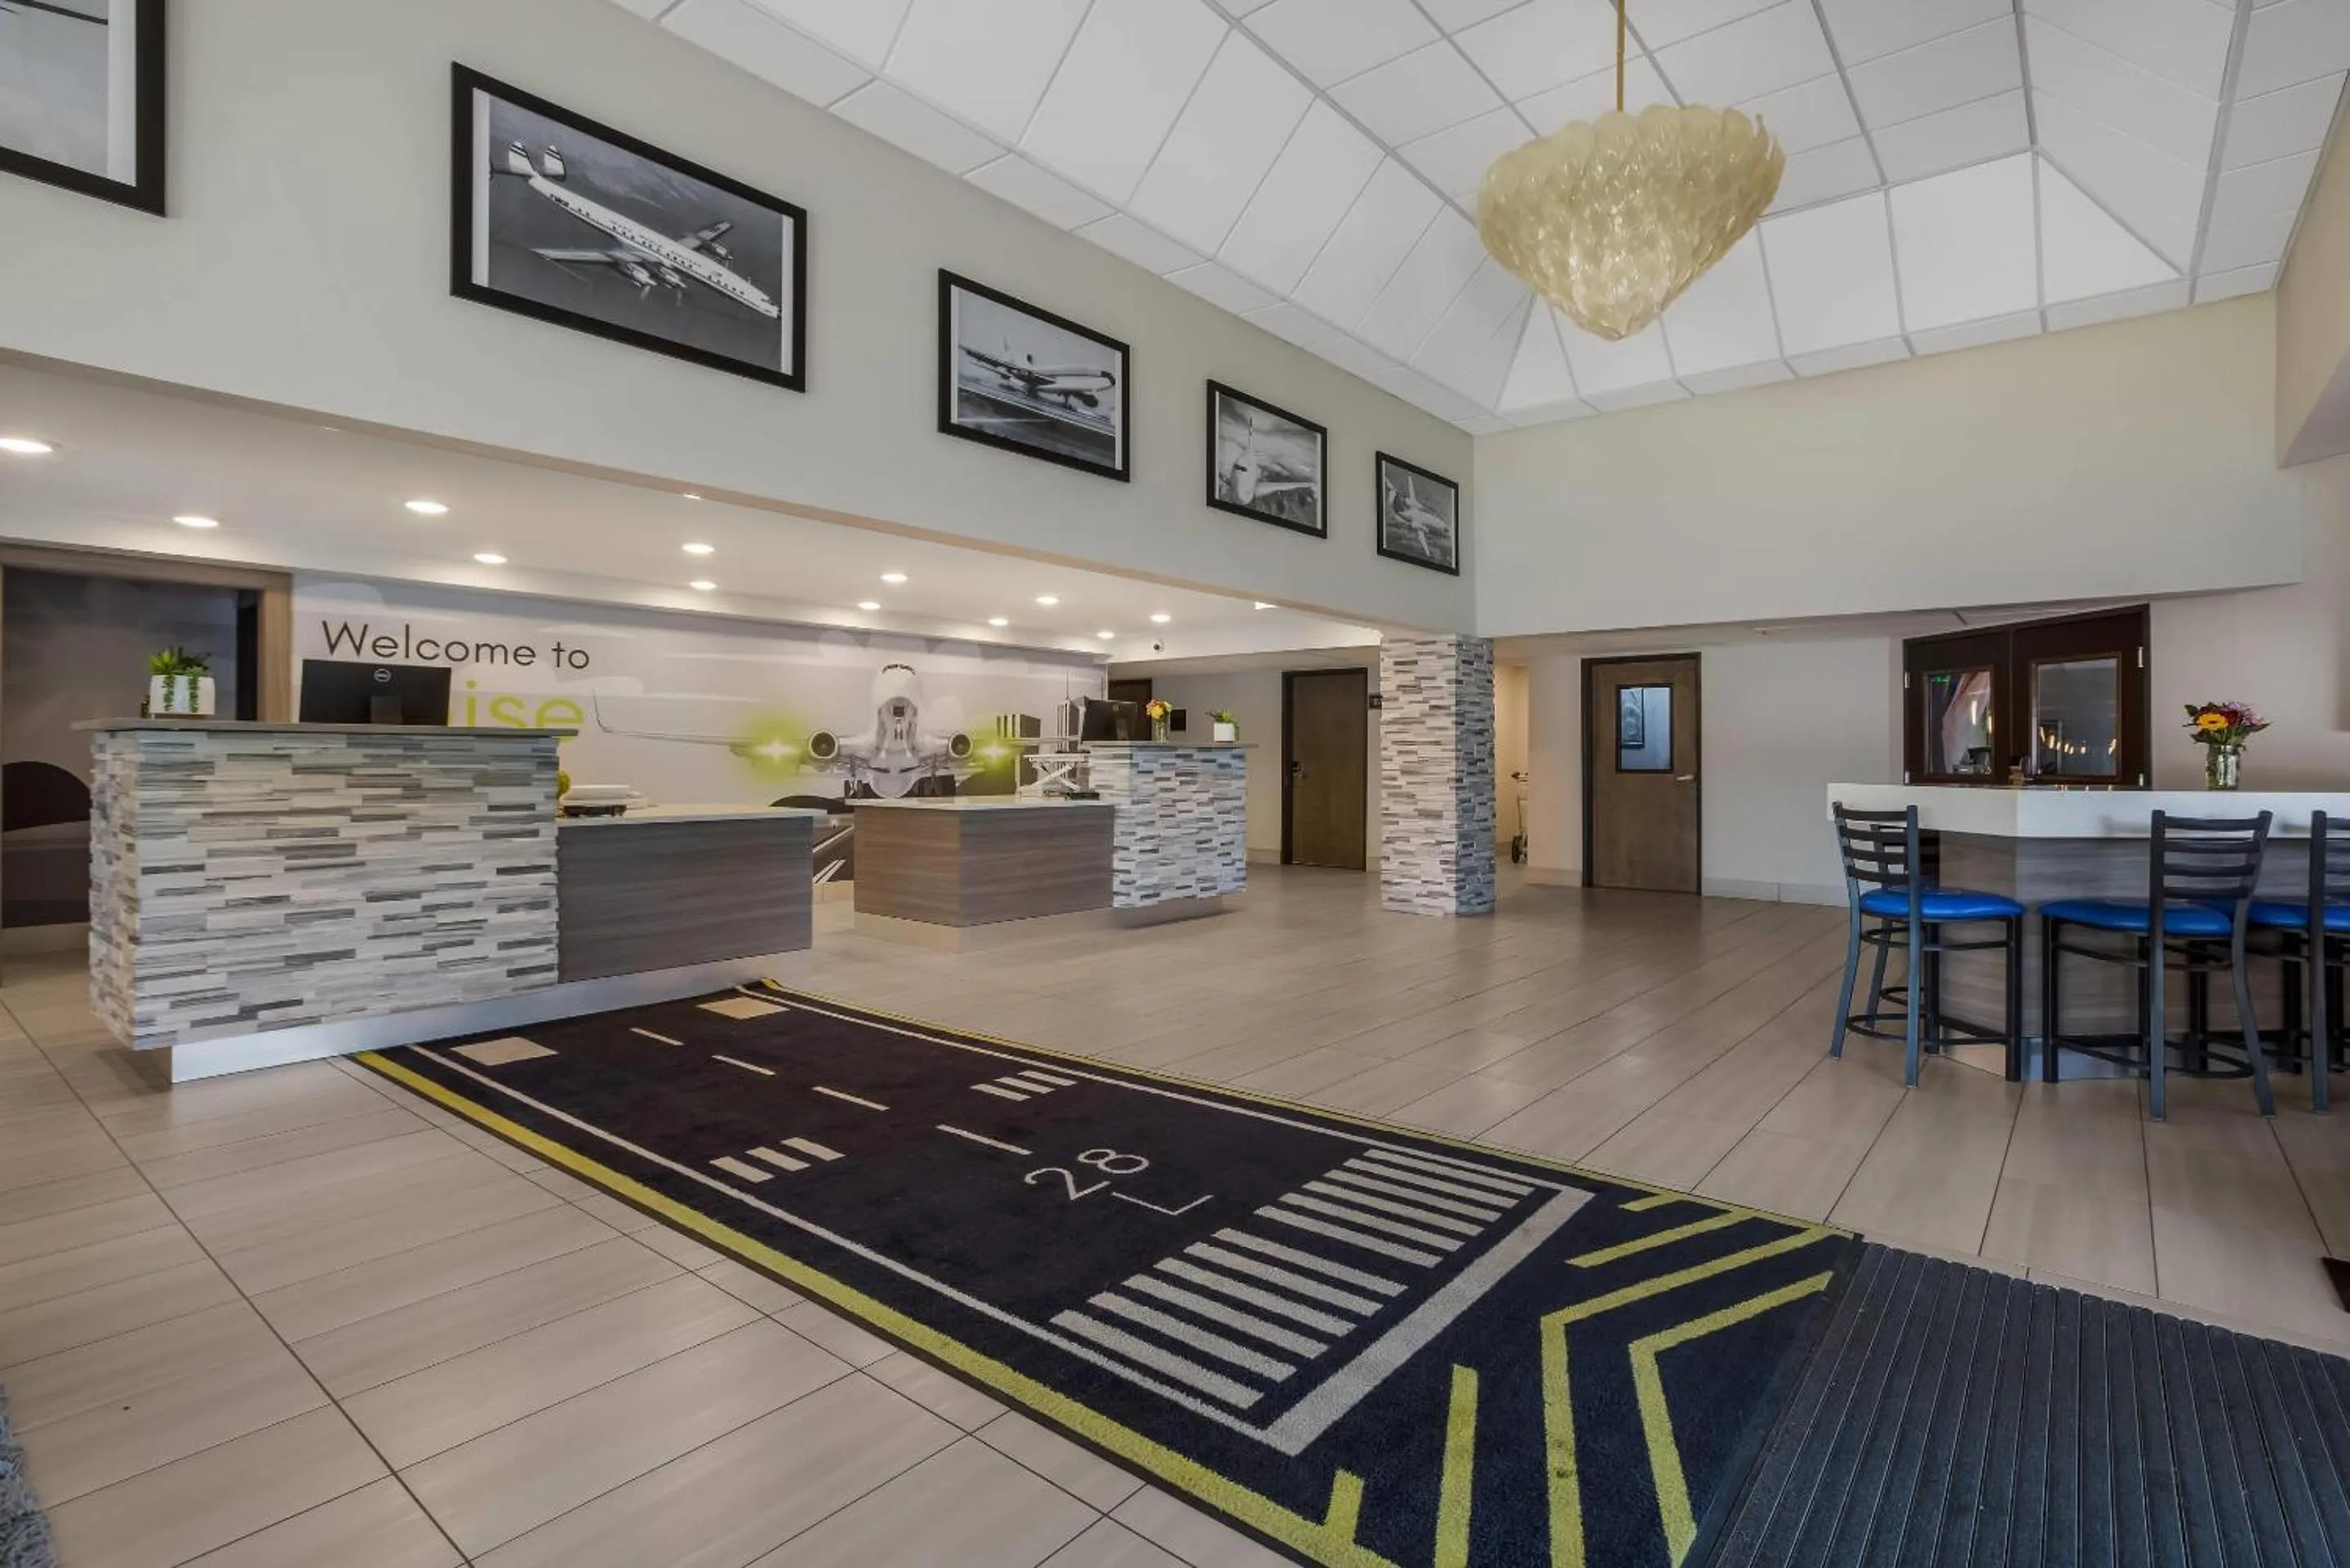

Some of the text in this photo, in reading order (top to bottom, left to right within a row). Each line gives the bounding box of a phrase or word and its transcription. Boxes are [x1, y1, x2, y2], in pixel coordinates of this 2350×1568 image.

[322, 620, 590, 669] Welcome to
[449, 680, 585, 743] ise
[1024, 1148, 1150, 1201] 28
[1111, 1191, 1215, 1216] L
